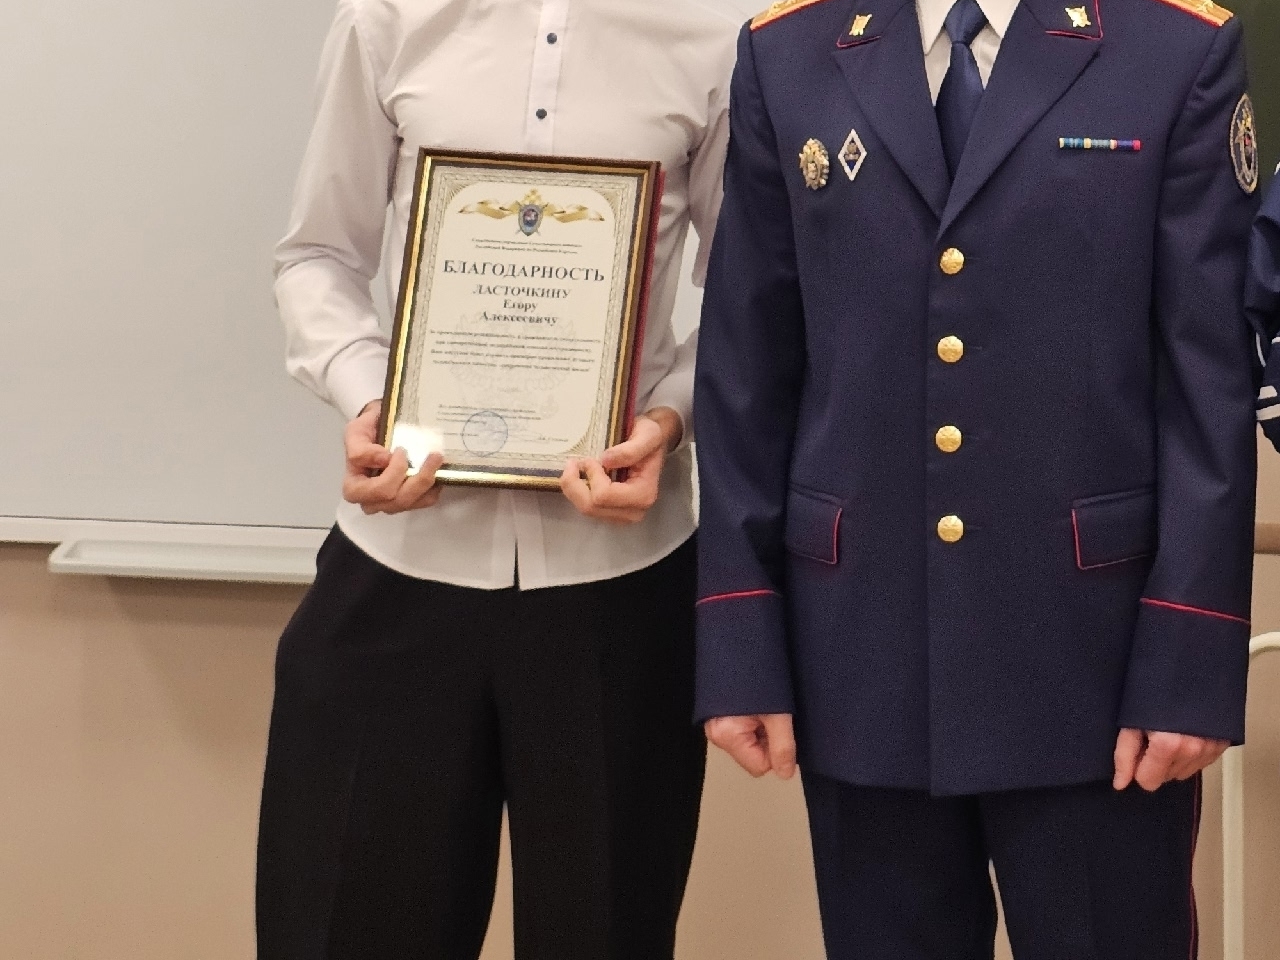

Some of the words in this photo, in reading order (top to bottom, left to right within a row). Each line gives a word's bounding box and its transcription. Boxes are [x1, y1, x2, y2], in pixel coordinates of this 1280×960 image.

[443, 260, 605, 282] БЛАГОДАРНОСТЬ
[473, 284, 571, 299] ЛАСТОЧКИНУ
[503, 299, 538, 312] Егору
[481, 311, 558, 327] Алексеевичу
